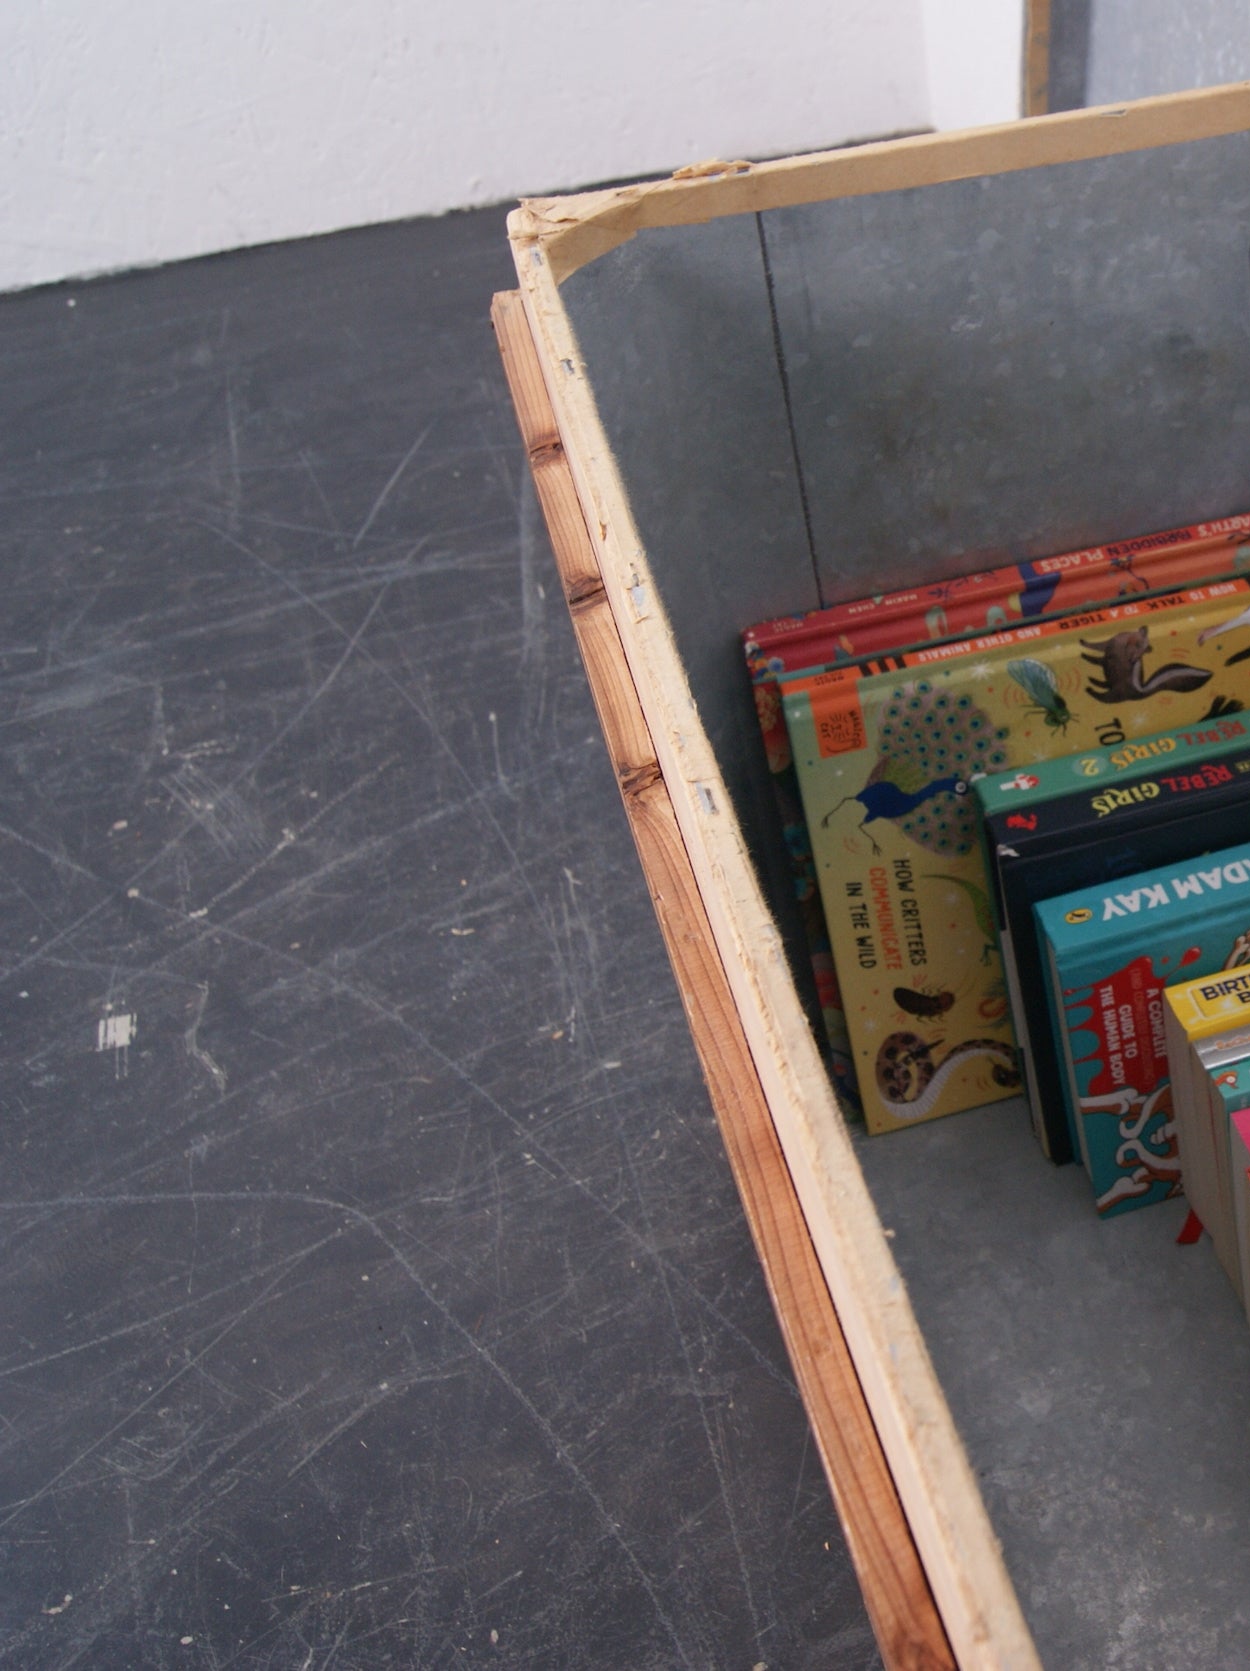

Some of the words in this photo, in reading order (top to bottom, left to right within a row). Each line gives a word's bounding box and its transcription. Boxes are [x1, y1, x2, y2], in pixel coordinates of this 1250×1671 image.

[1039, 550, 1103, 572] PLACES
[1147, 595, 1183, 611] TALK
[1208, 582, 1235, 597] HOW
[917, 642, 970, 661] ANIMALS
[976, 633, 1012, 648] OTHER
[1094, 717, 1125, 746] TO
[1078, 756, 1101, 778] 2
[1160, 762, 1232, 797] REBEL
[1090, 779, 1162, 816] GIRLS
[893, 859, 913, 892] HOW
[846, 882, 862, 897] IN
[1098, 885, 1169, 918] KAY
[849, 903, 869, 929] THE
[870, 867, 904, 970] COMMUNICATE
[902, 898, 927, 966] CRITTERS
[856, 931, 876, 968] WILD
[1100, 985, 1114, 1007] THE
[1147, 988, 1158, 998] A
[1103, 1009, 1120, 1051] HUMAN
[1119, 1005, 1135, 1039] GUIDE
[1125, 1042, 1137, 1058] TO
[1109, 1054, 1126, 1084] BODY
